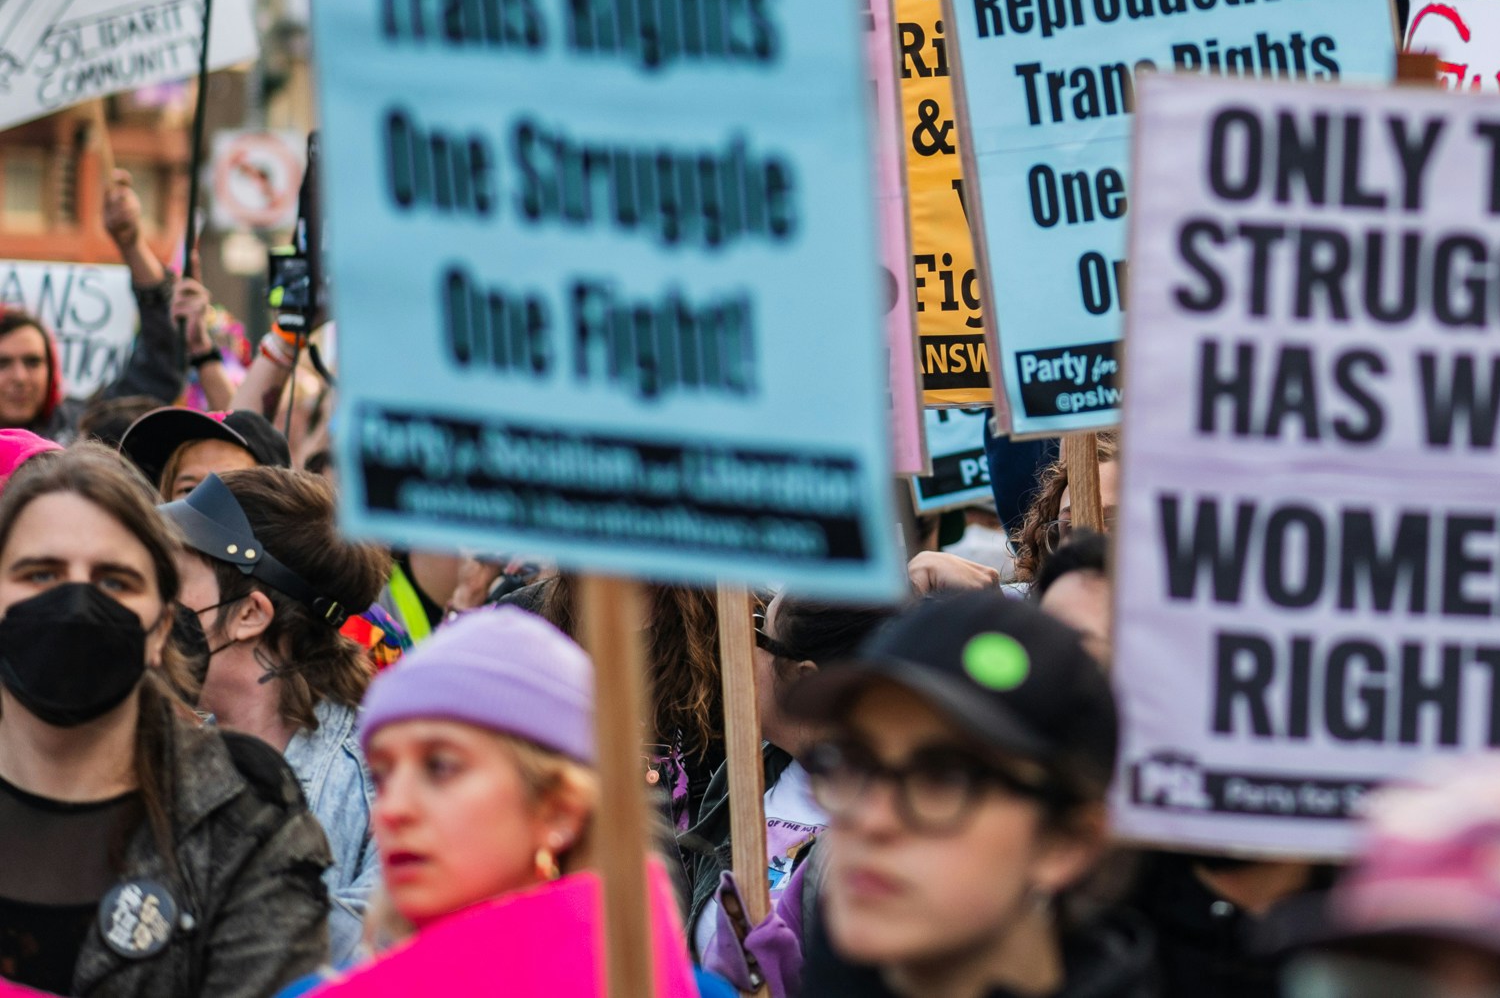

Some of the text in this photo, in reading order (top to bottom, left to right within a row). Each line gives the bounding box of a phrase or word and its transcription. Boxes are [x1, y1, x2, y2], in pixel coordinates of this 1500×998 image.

[381, 104, 800, 247] One Struggle
[911, 98, 956, 157] &
[1206, 106, 1443, 211] ONLY
[1028, 163, 1128, 229] One
[440, 261, 553, 376] One
[1020, 351, 1088, 386] Party
[1195, 338, 1390, 446] HAS
